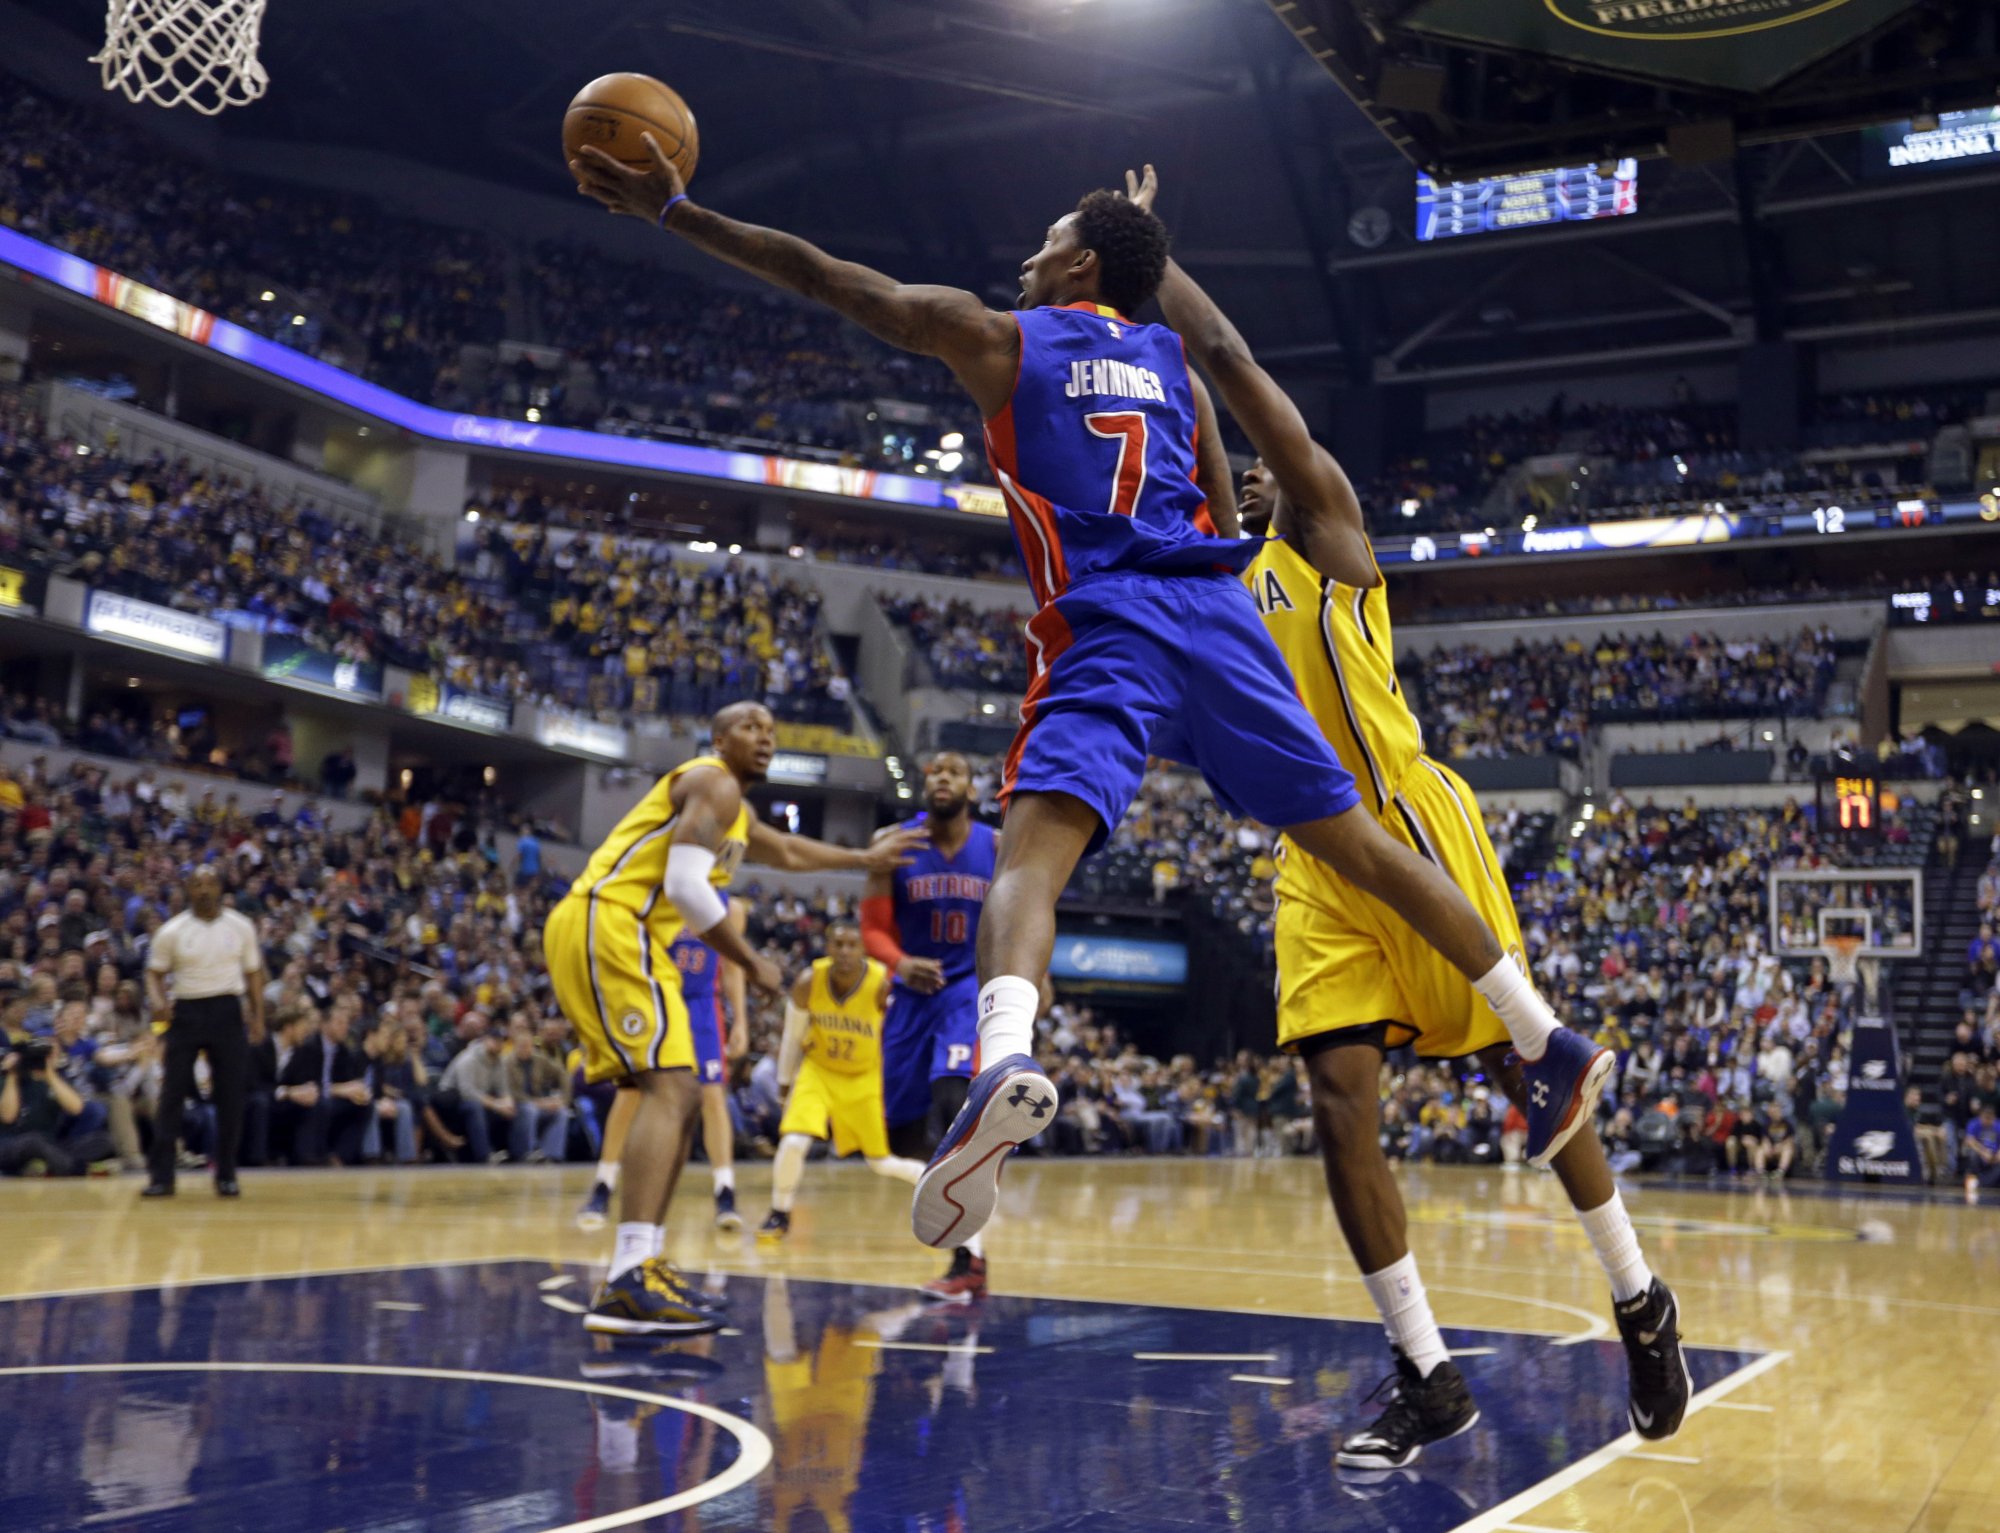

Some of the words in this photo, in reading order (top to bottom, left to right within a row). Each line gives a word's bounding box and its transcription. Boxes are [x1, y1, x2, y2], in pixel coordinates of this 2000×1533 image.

[1065, 358, 1167, 402] JENNINGS
[1084, 410, 1149, 518] 7
[1812, 506, 1845, 534] 12
[905, 872, 991, 904] DETROIT
[931, 909, 968, 945] 10
[826, 1037, 855, 1063] 32
[946, 1043, 971, 1070] P
